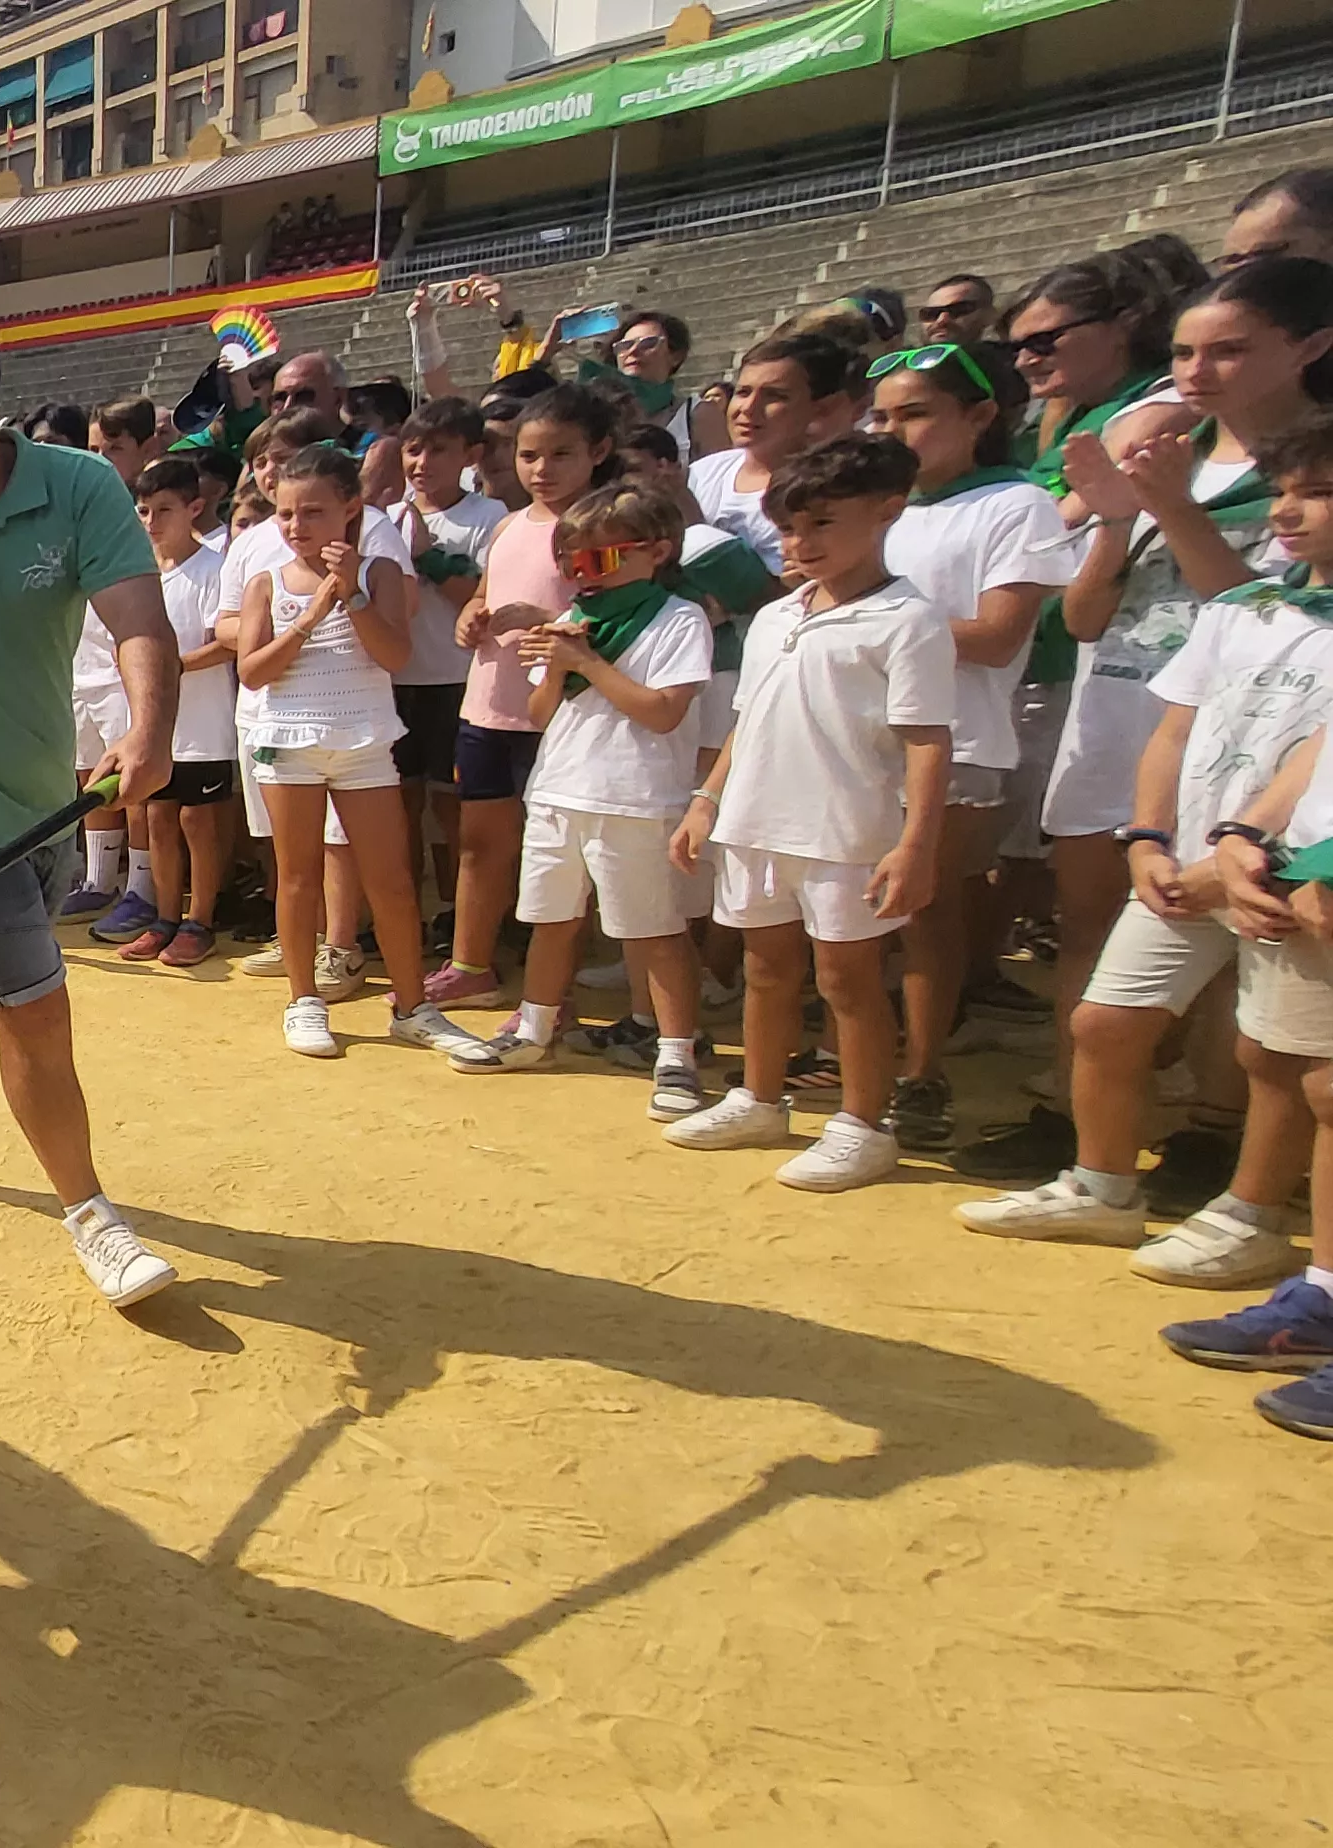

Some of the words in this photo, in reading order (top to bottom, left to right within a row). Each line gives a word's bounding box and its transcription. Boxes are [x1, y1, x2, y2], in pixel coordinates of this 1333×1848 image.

[620, 70, 733, 109] FELICES
[429, 92, 594, 149] TAUROEMOCIÓN
[1240, 667, 1317, 693] EÑA
